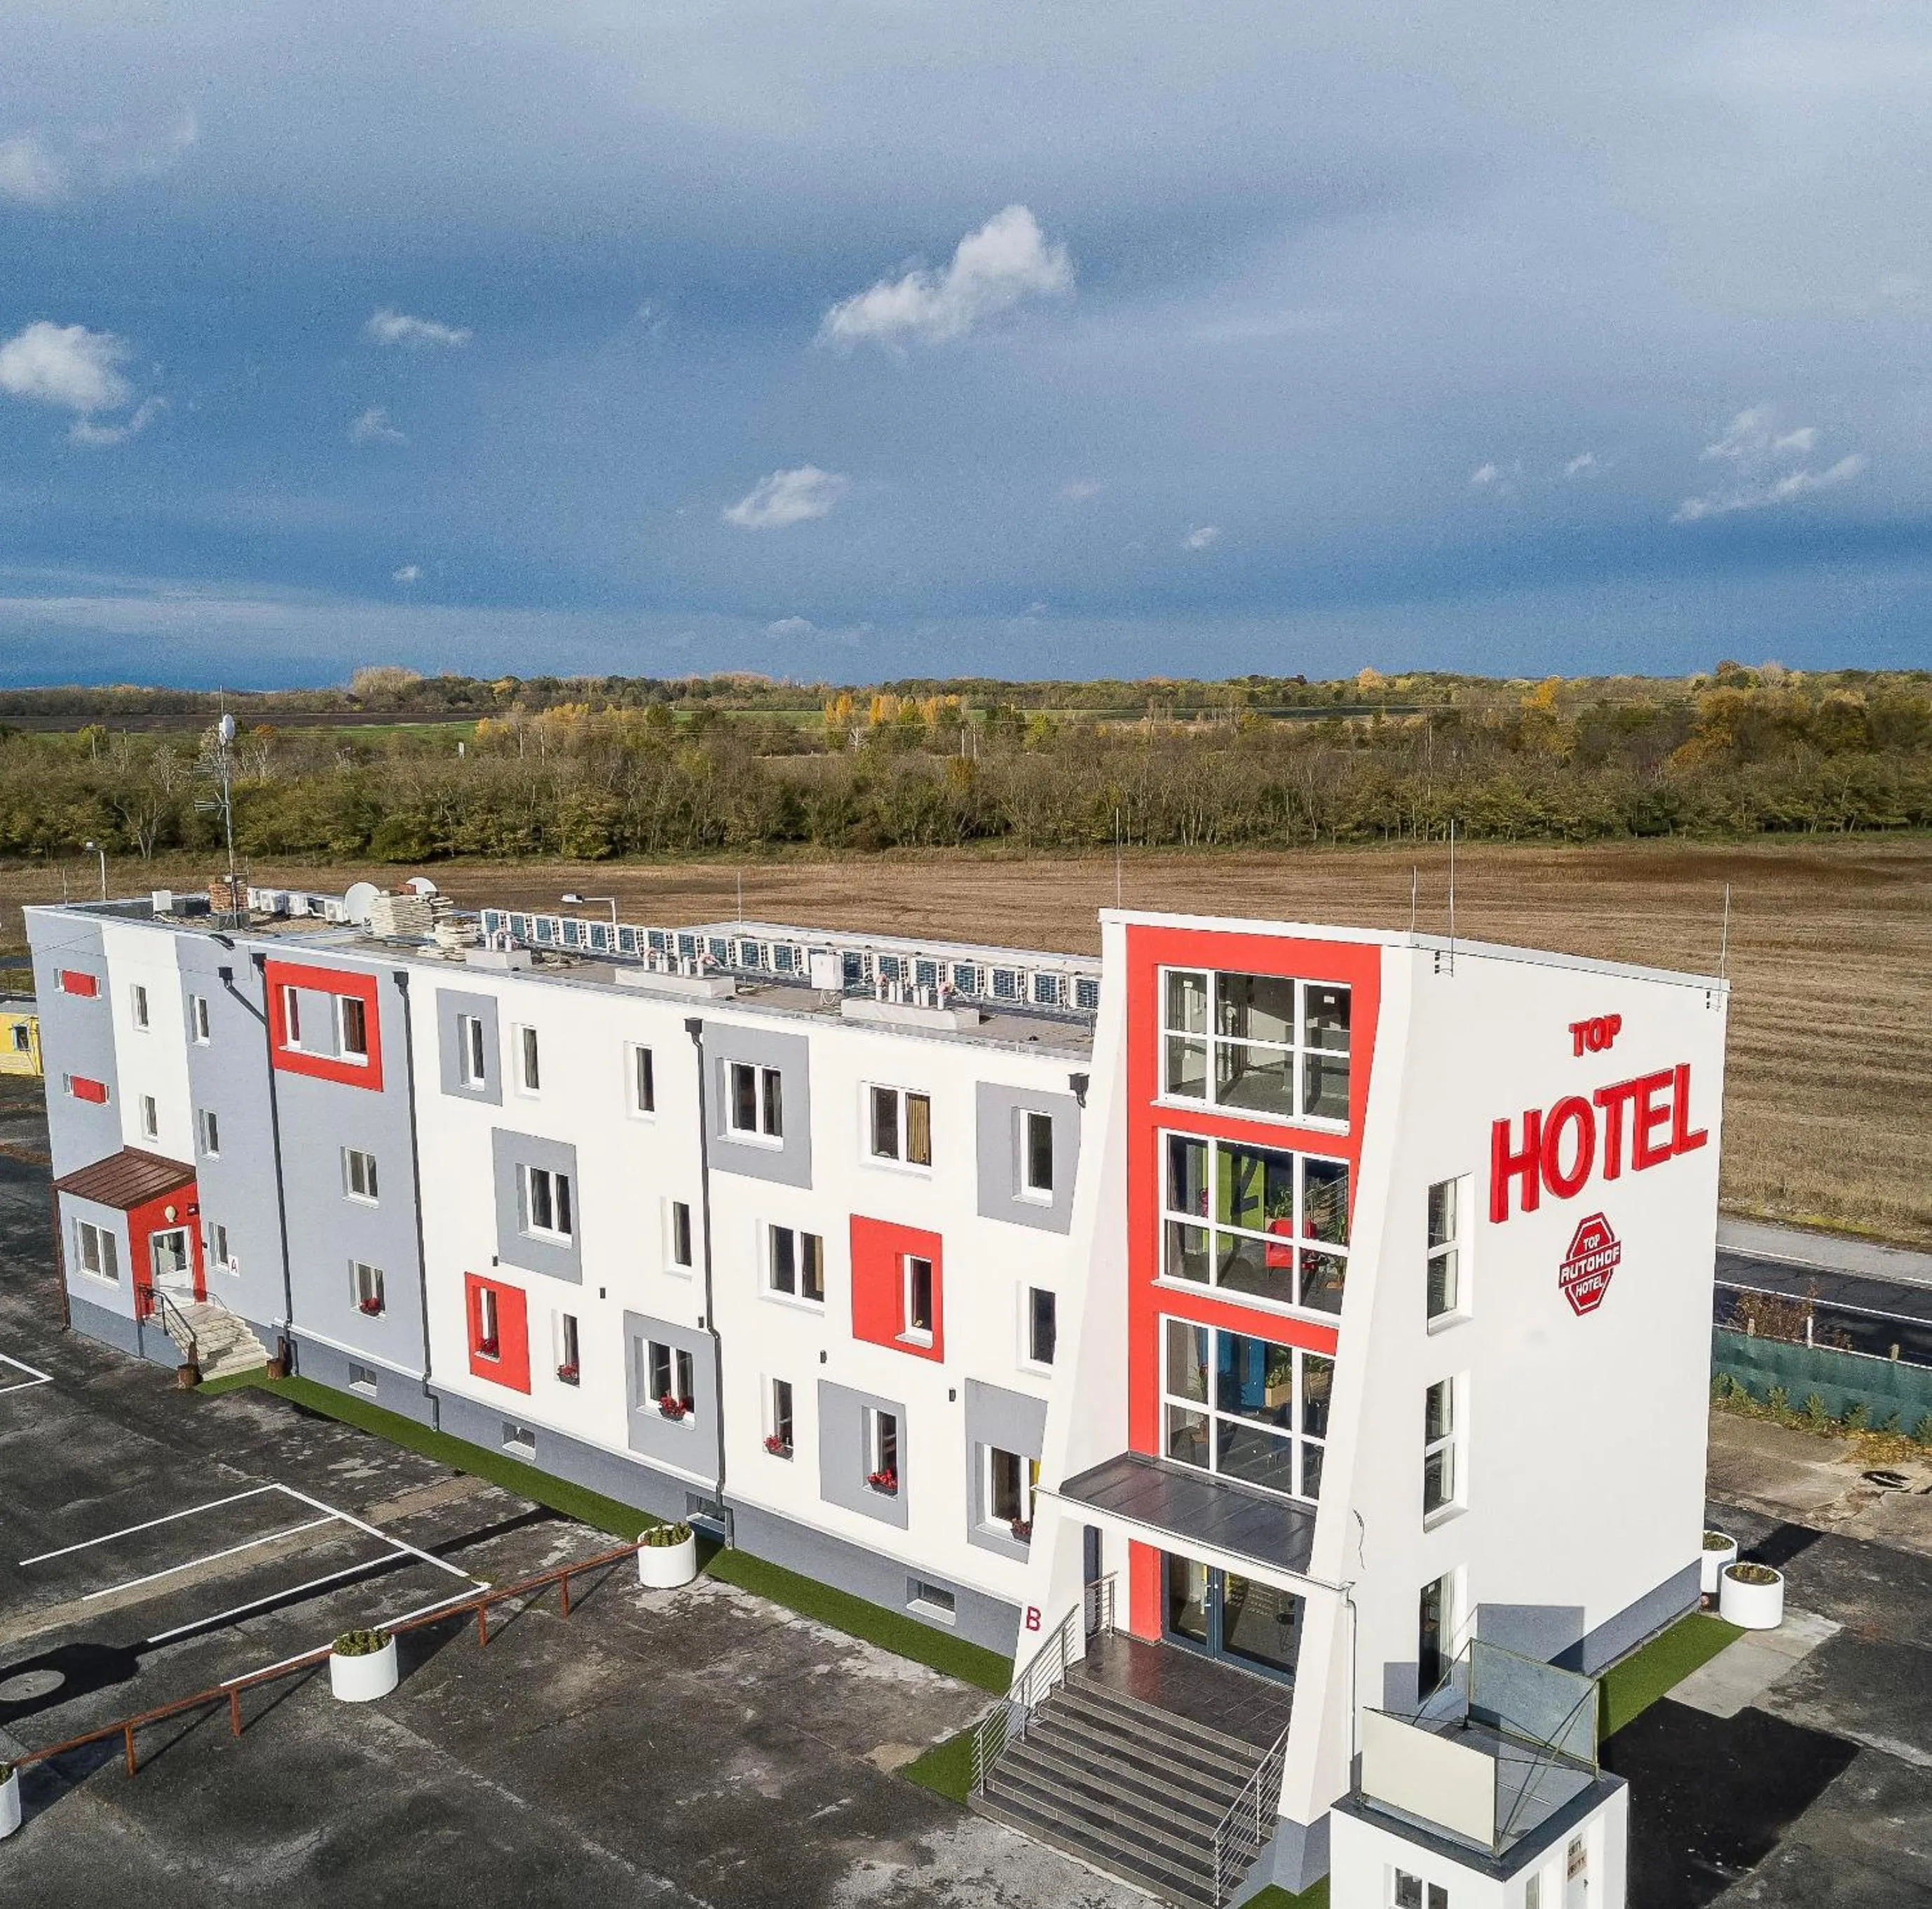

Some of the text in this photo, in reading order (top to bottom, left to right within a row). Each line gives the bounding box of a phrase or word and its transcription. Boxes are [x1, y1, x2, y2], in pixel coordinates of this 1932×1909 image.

[1569, 1014, 1621, 1057] TOP
[1489, 1063, 1708, 1224] HOTEL
[1583, 1233, 1600, 1251] TOP
[1560, 1245, 1619, 1284] AUTOHOF
[1576, 1275, 1603, 1298] HOTEL
[1026, 1605, 1042, 1631] B
